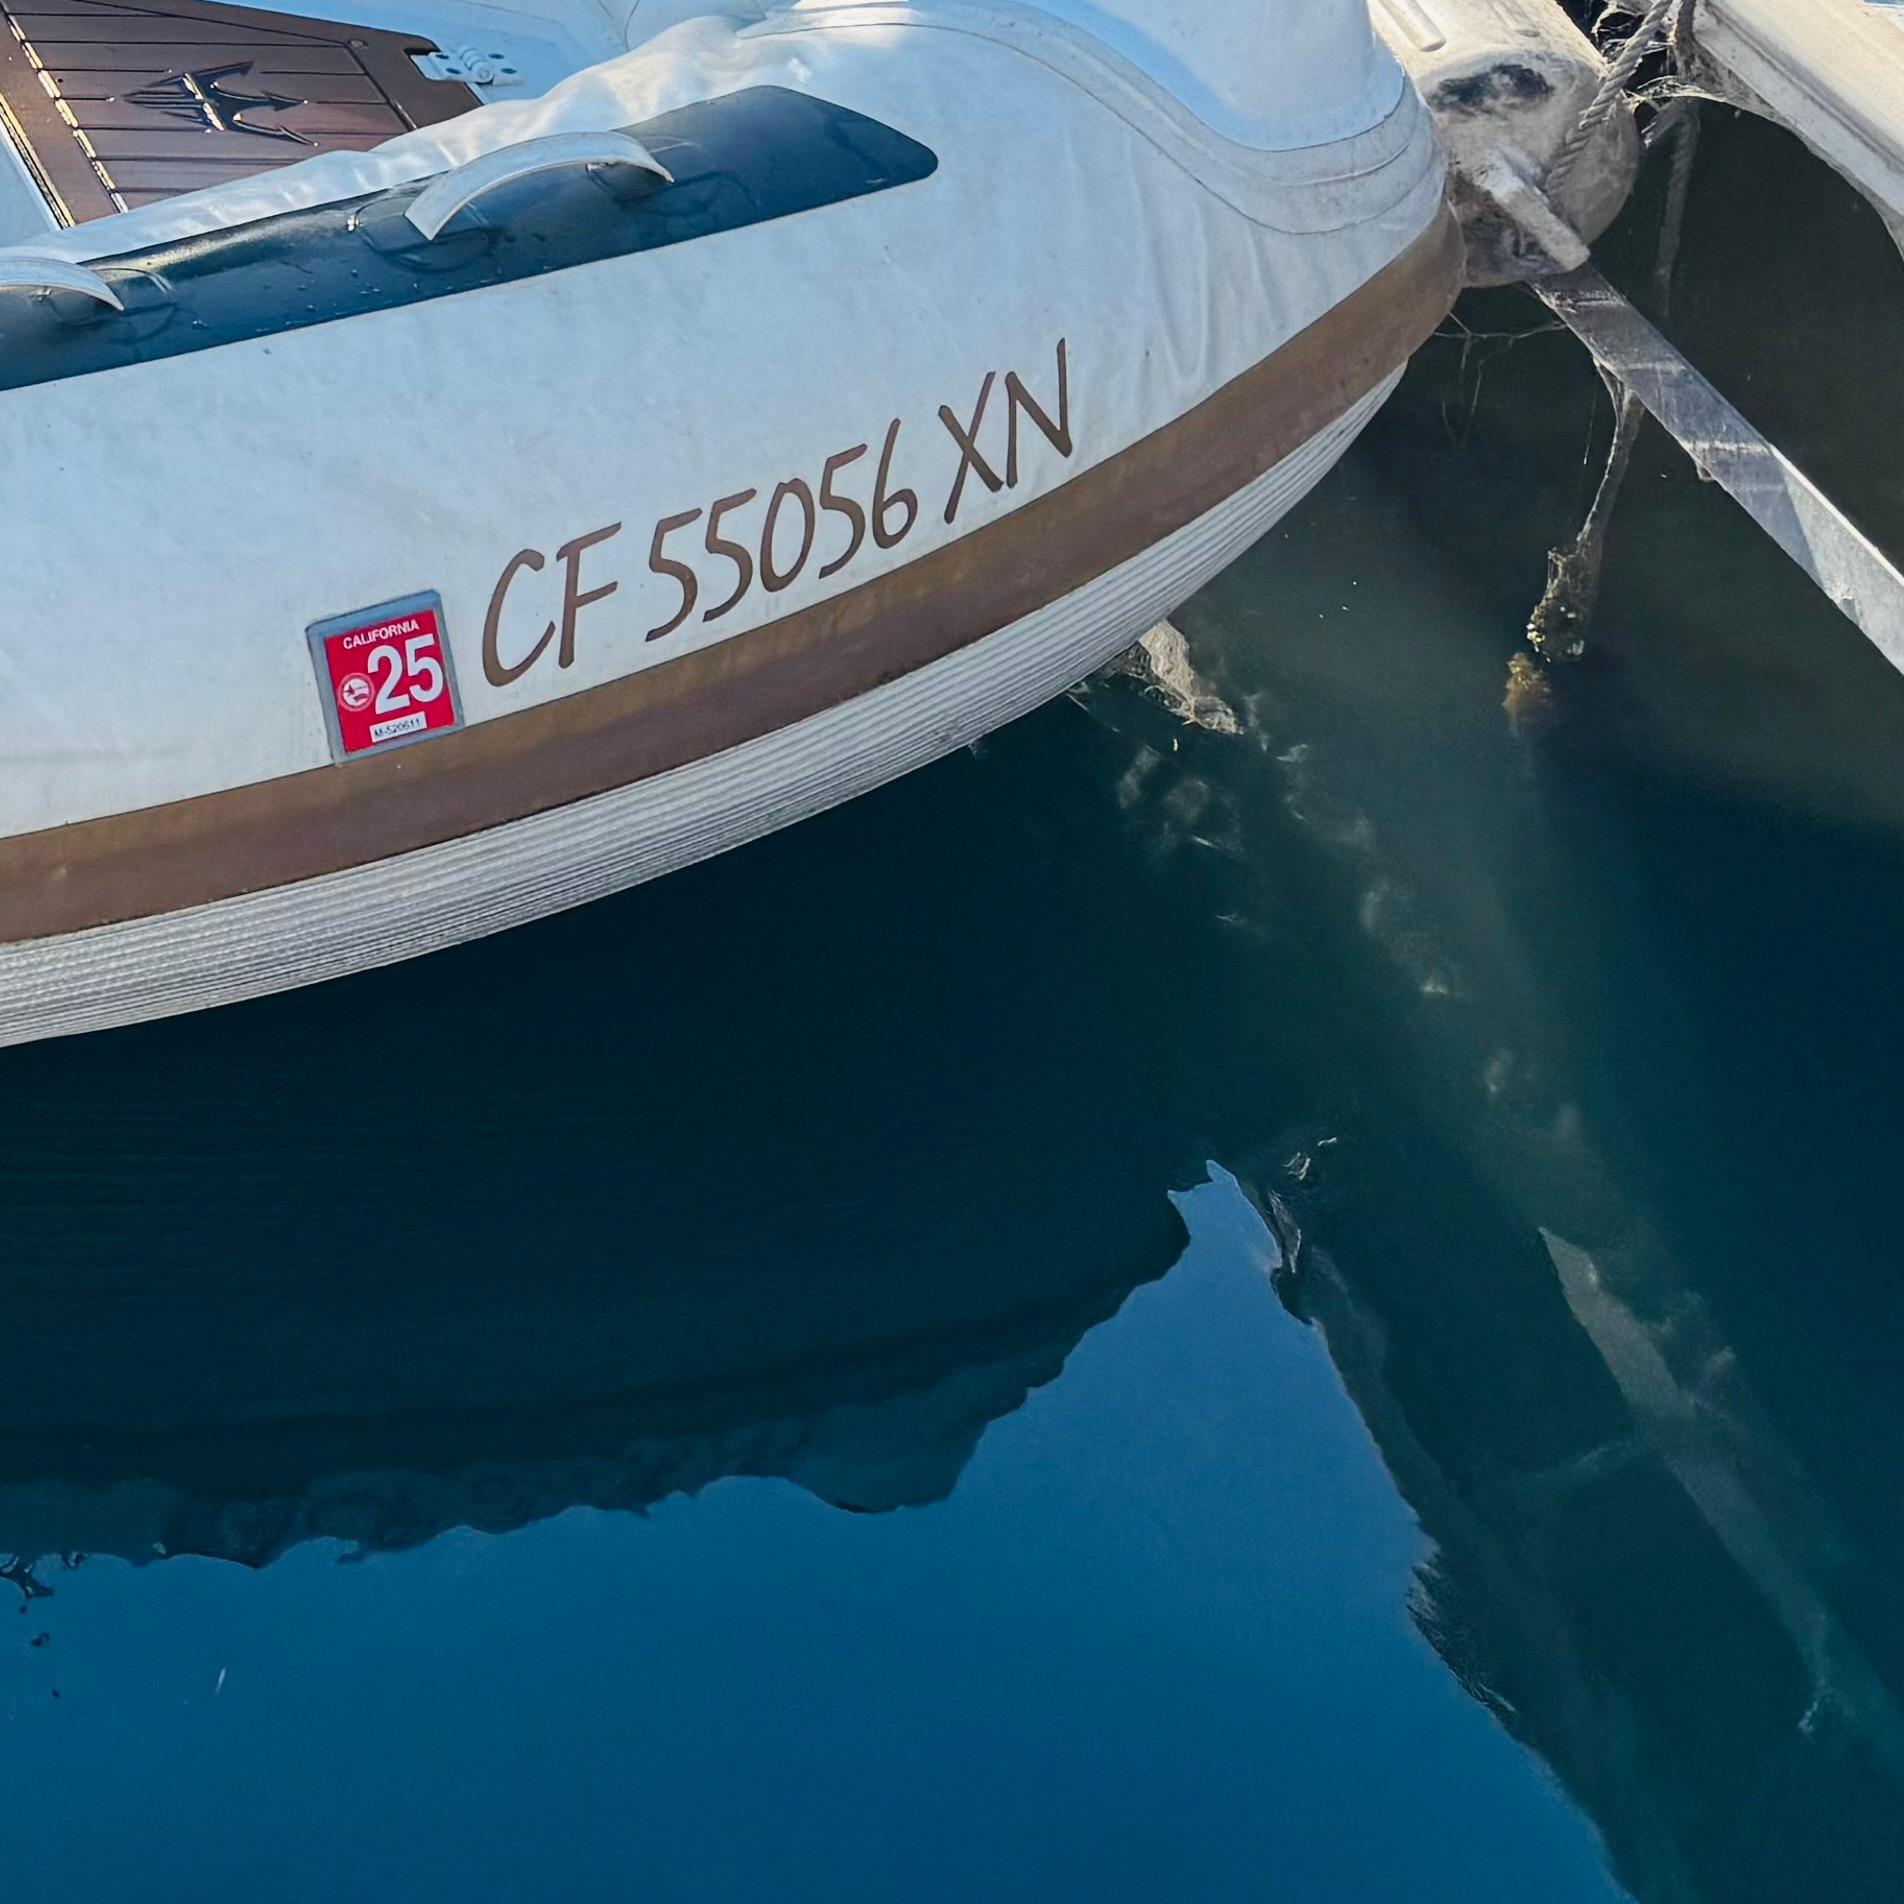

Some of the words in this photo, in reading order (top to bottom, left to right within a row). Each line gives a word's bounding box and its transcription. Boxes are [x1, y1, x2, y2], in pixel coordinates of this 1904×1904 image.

[482, 521, 622, 688] CF
[645, 418, 919, 643] 55056
[938, 337, 1074, 523] XN
[343, 619, 420, 650] CALIFORNIA
[367, 633, 443, 715] 25
